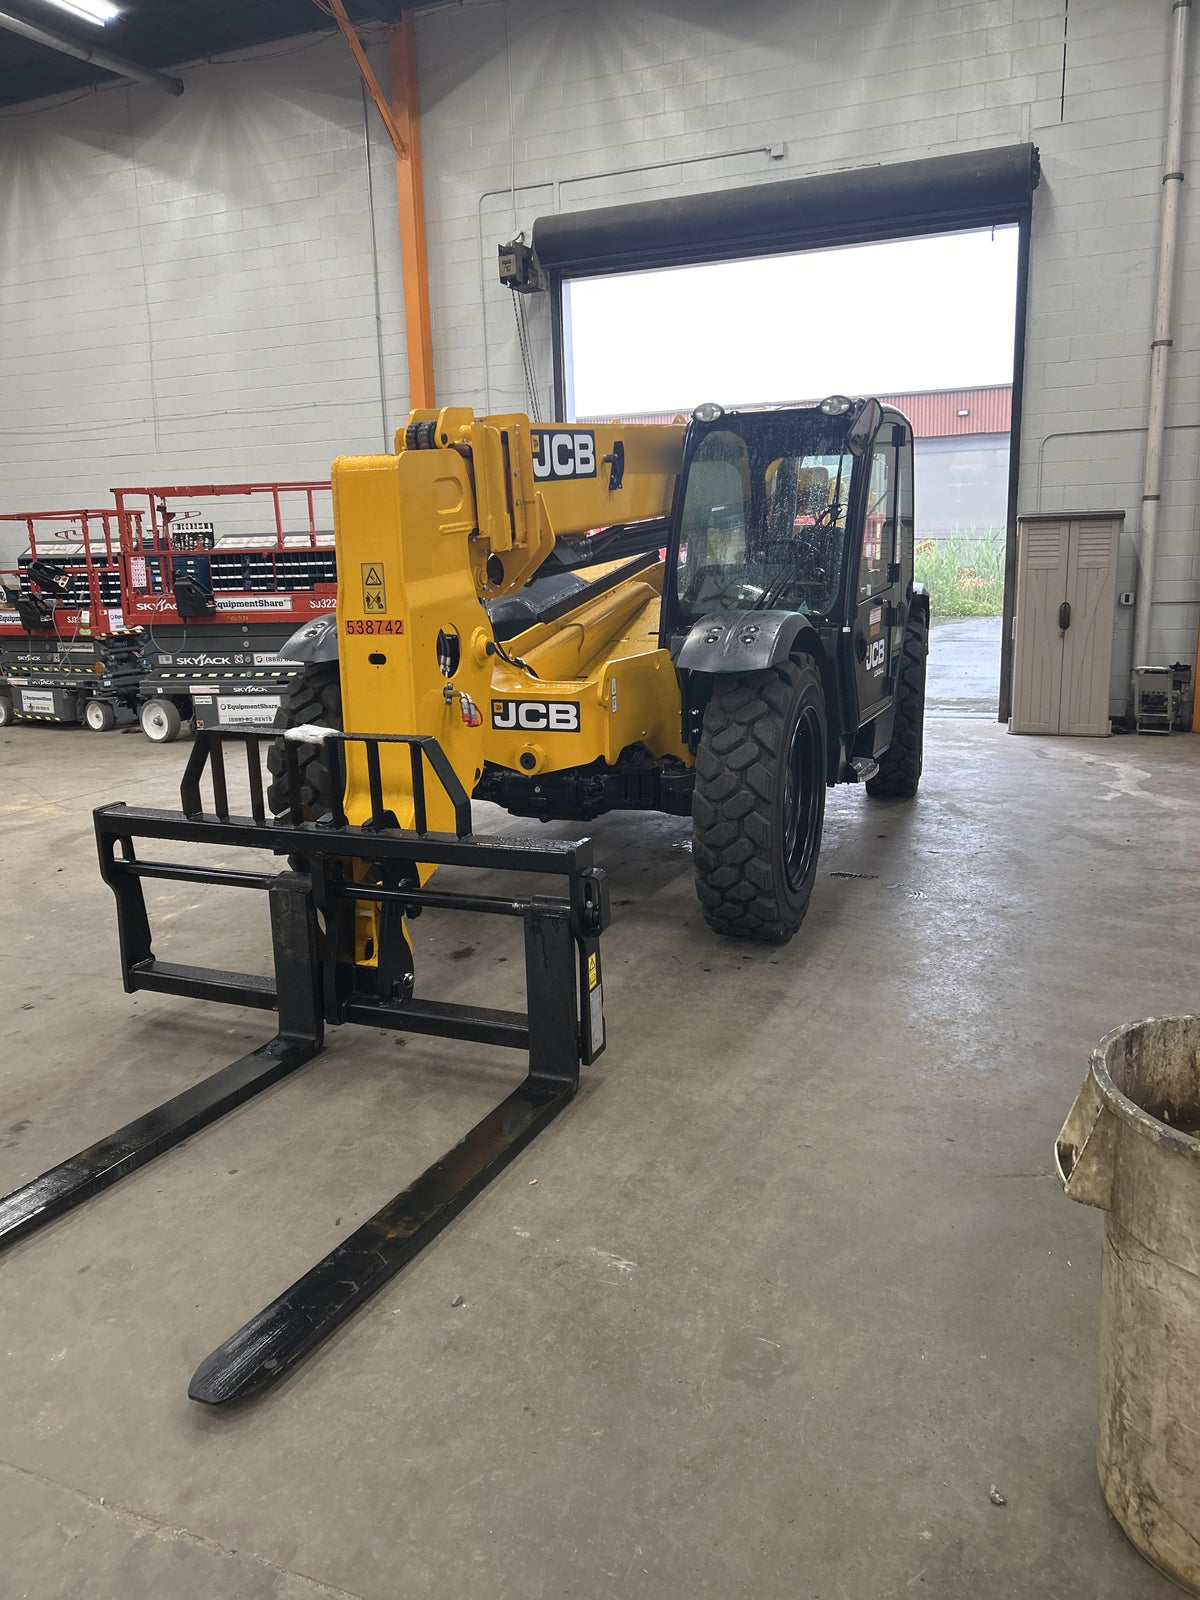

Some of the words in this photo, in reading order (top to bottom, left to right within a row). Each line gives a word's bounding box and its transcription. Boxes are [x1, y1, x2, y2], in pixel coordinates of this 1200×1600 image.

[532, 433, 596, 478] JCB
[346, 620, 403, 635] 538742
[176, 654, 231, 666] SKYJACK
[866, 638, 884, 670] JCB
[494, 703, 578, 730] JCB
